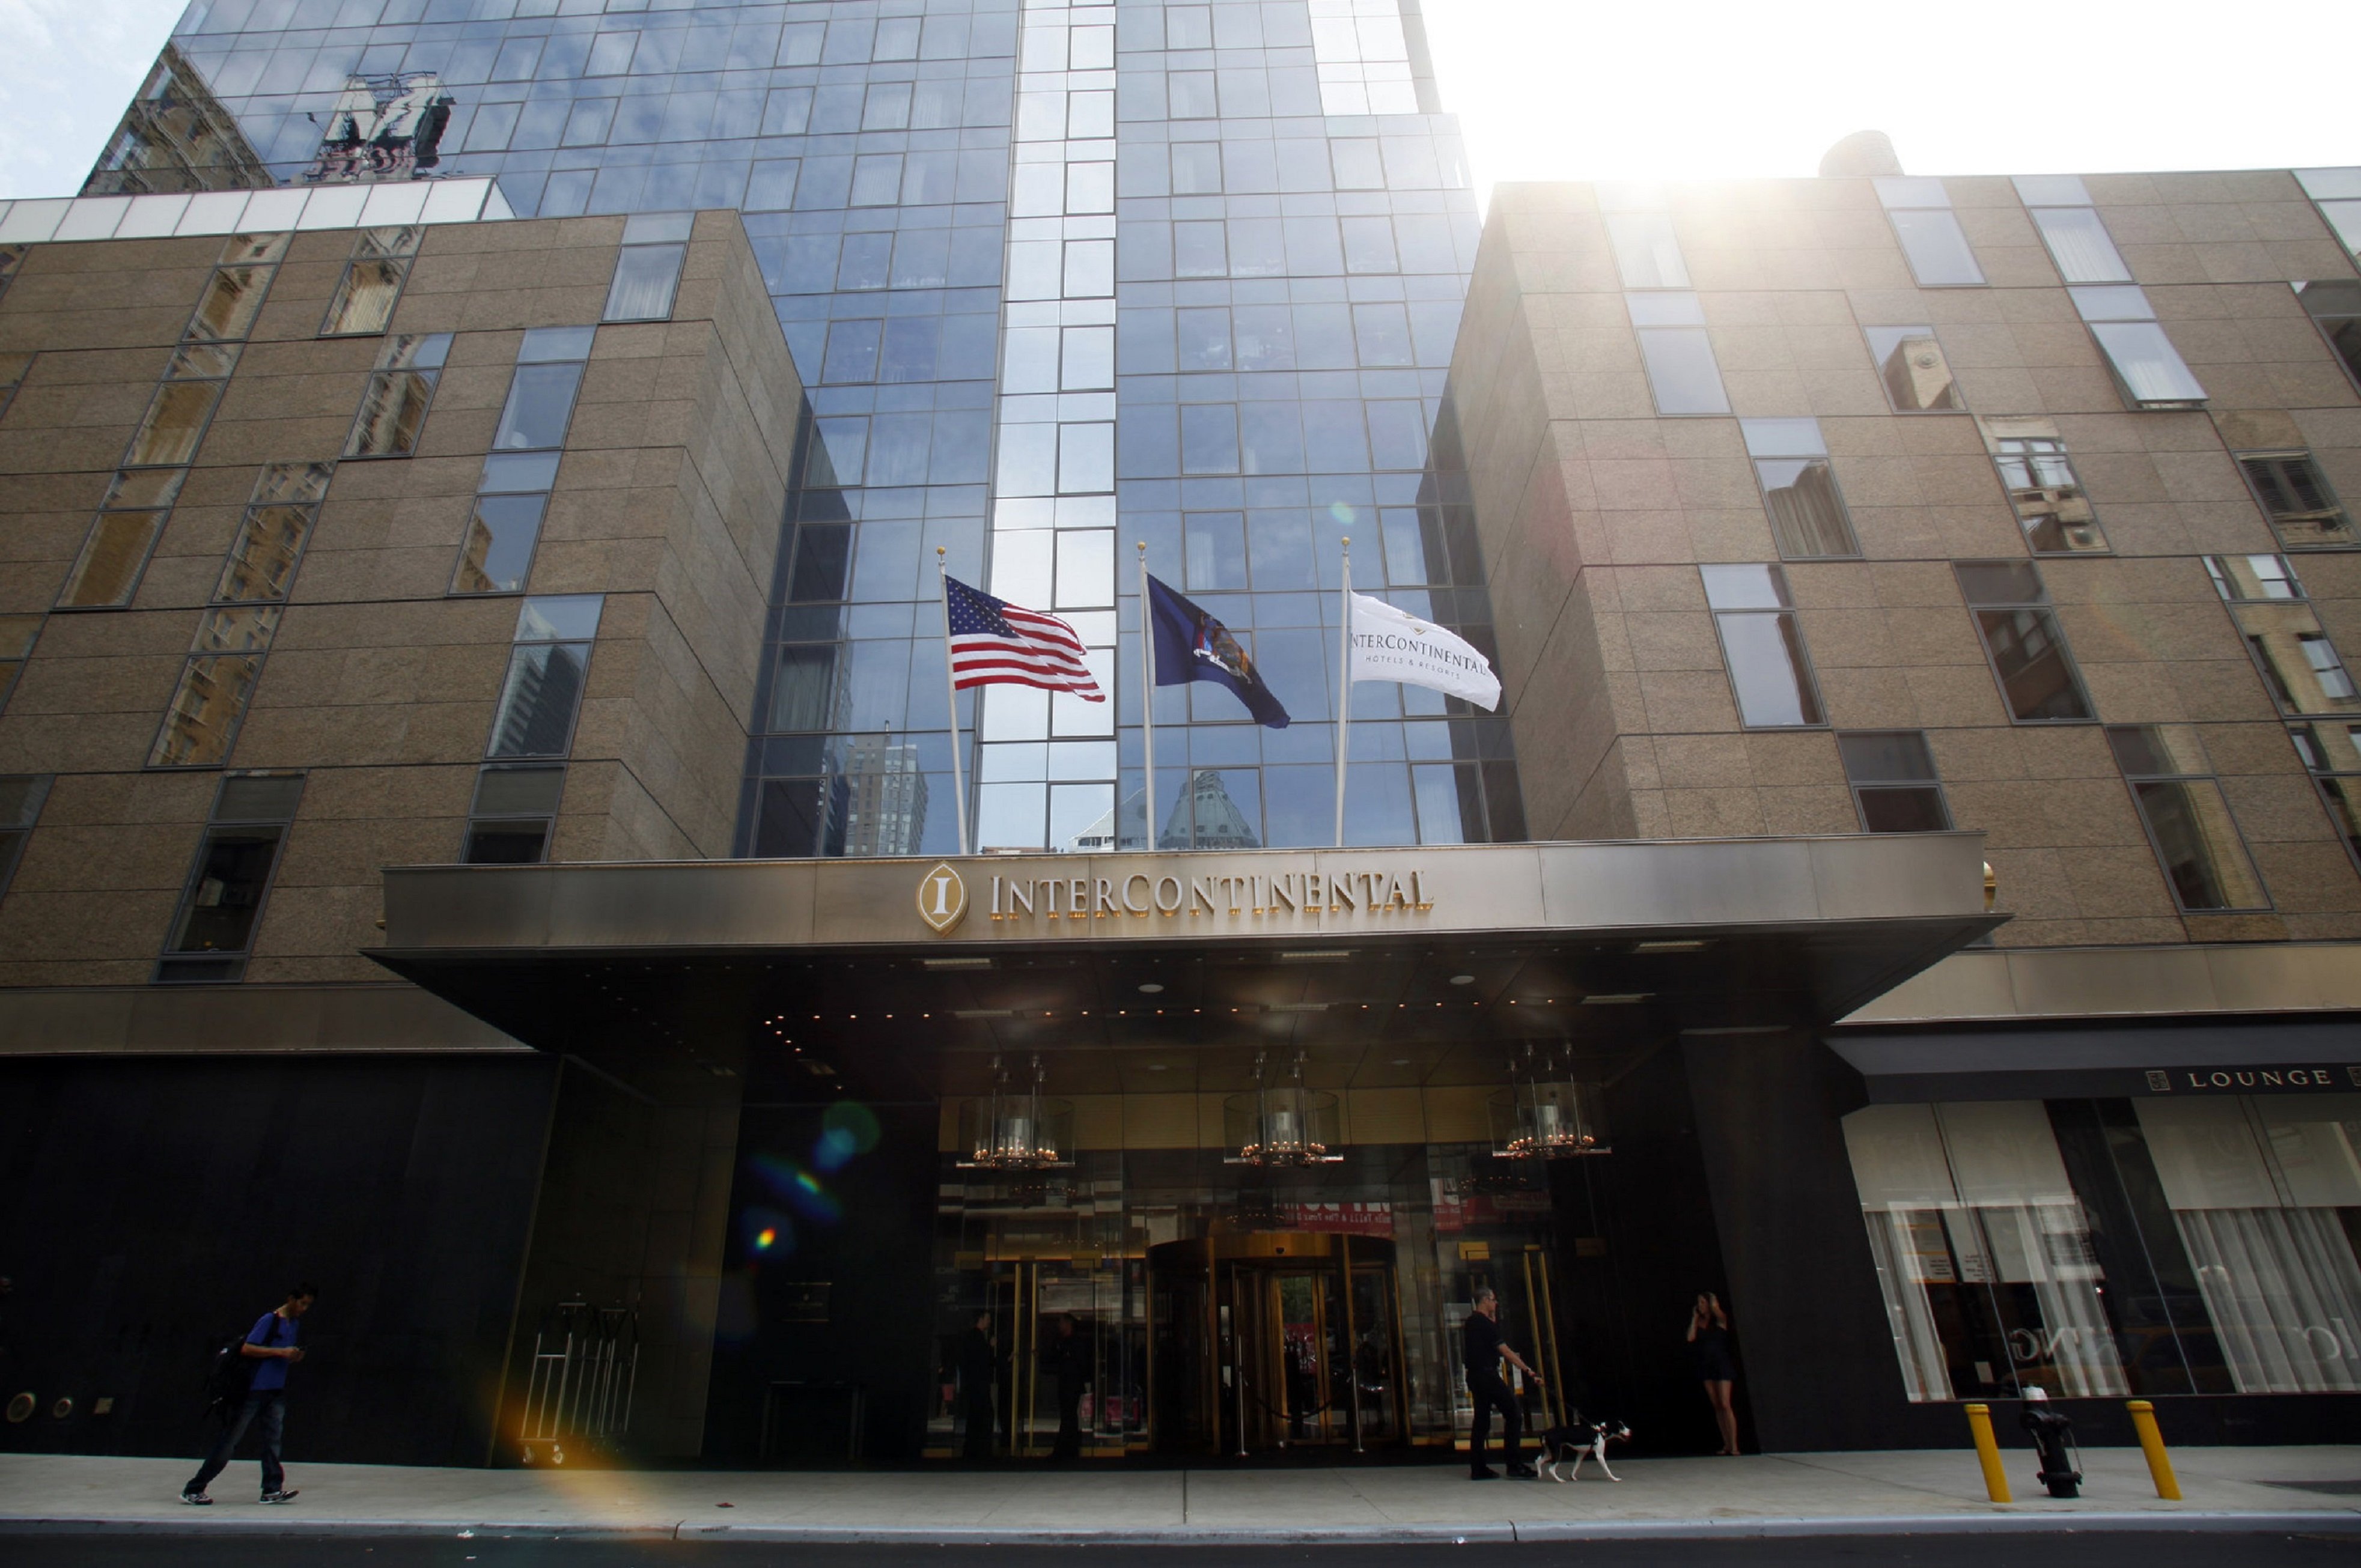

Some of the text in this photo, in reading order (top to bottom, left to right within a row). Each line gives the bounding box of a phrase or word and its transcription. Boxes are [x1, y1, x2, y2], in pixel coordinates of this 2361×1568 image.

[1365, 655, 1403, 664] HOTELS
[1419, 662, 1460, 680] RESORTS
[989, 871, 1434, 919] INTERCONTINENTAL
[2187, 1069, 2333, 1088] LOUNGE
